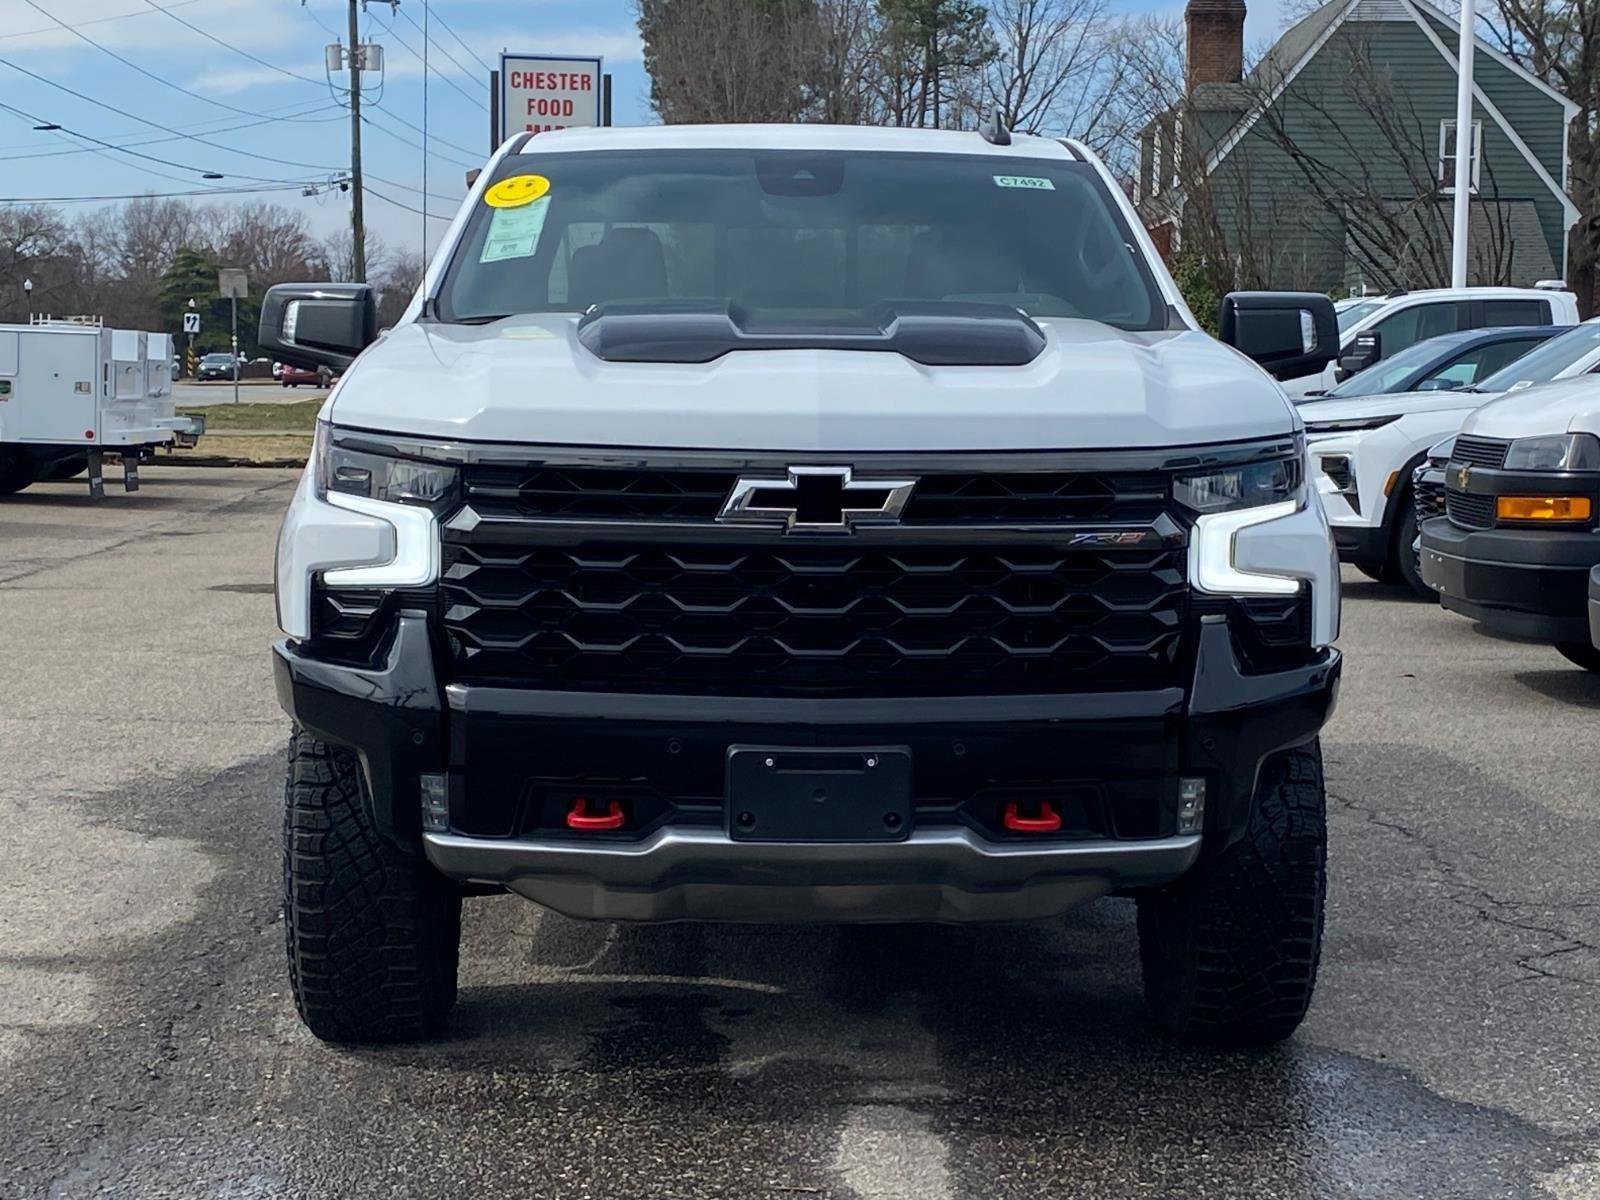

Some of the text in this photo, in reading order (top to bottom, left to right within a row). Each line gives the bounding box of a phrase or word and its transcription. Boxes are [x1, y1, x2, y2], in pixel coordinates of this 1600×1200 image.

[511, 71, 591, 91] CHESTER
[527, 98, 574, 117] FOOD
[999, 177, 1045, 187] C7492
